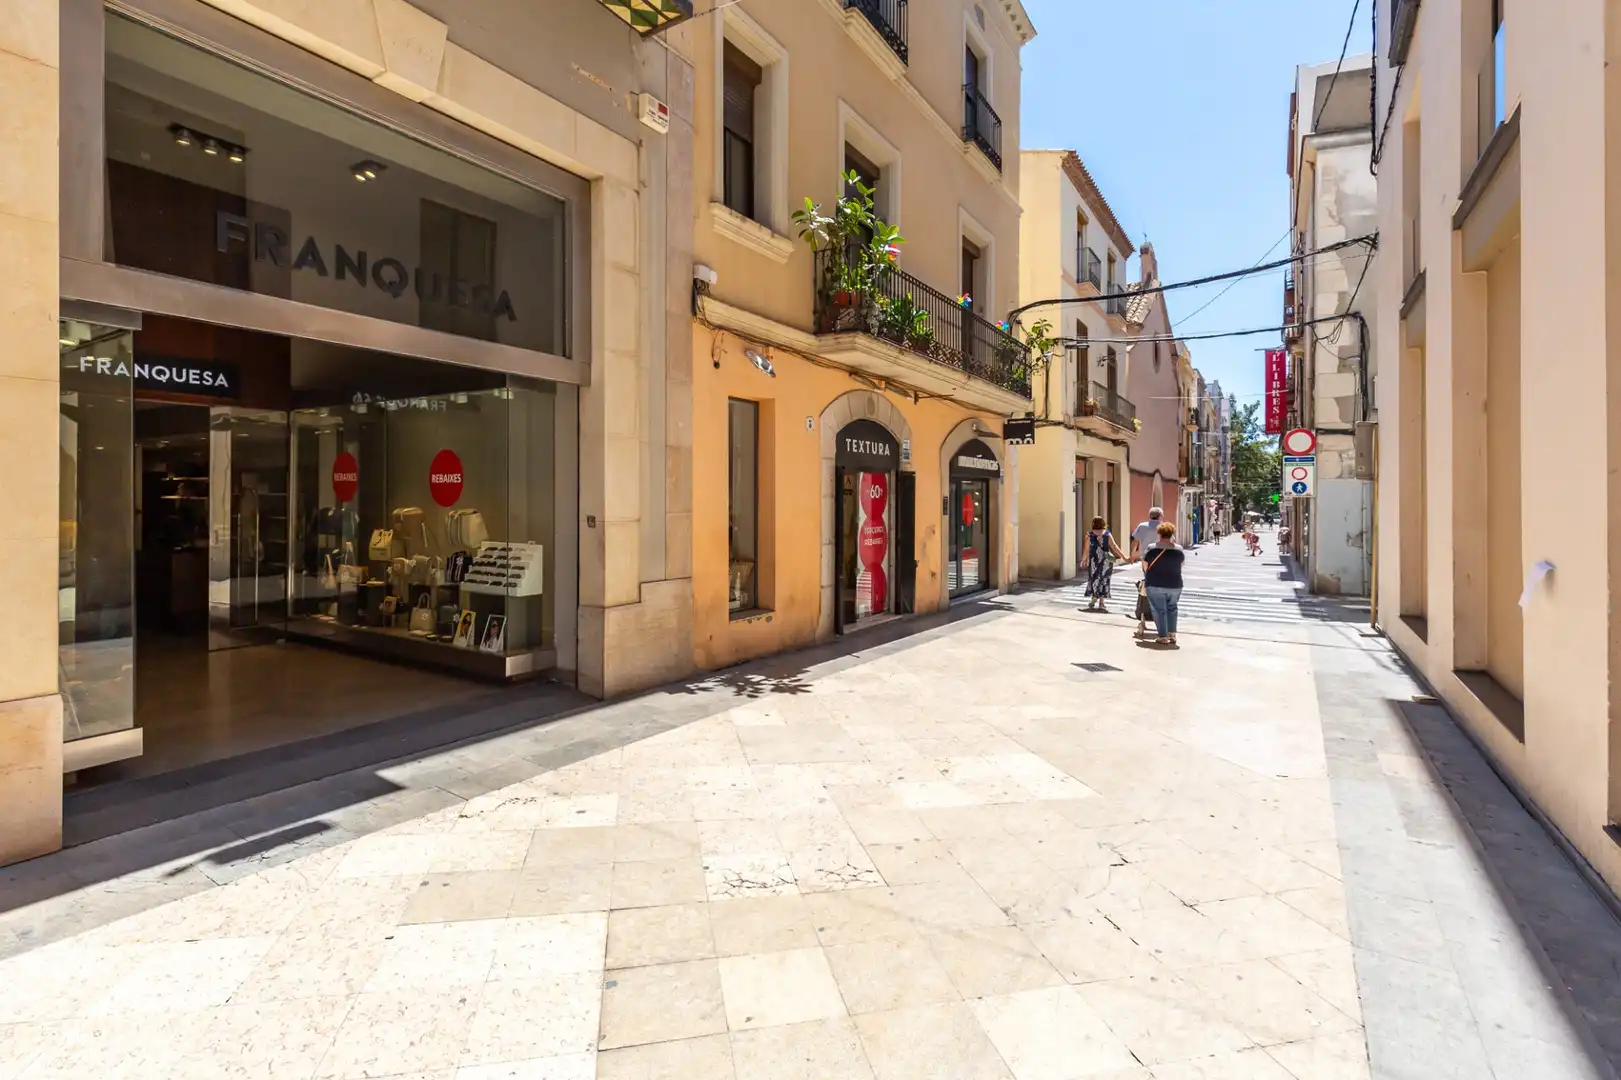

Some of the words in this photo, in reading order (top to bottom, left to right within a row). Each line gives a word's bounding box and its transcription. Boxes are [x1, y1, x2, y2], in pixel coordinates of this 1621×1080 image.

[216, 209, 518, 323] FRANQUESA
[79, 355, 229, 388] FRANQUESA
[845, 438, 891, 456] TEXTURA
[431, 473, 462, 484] REBAIXES
